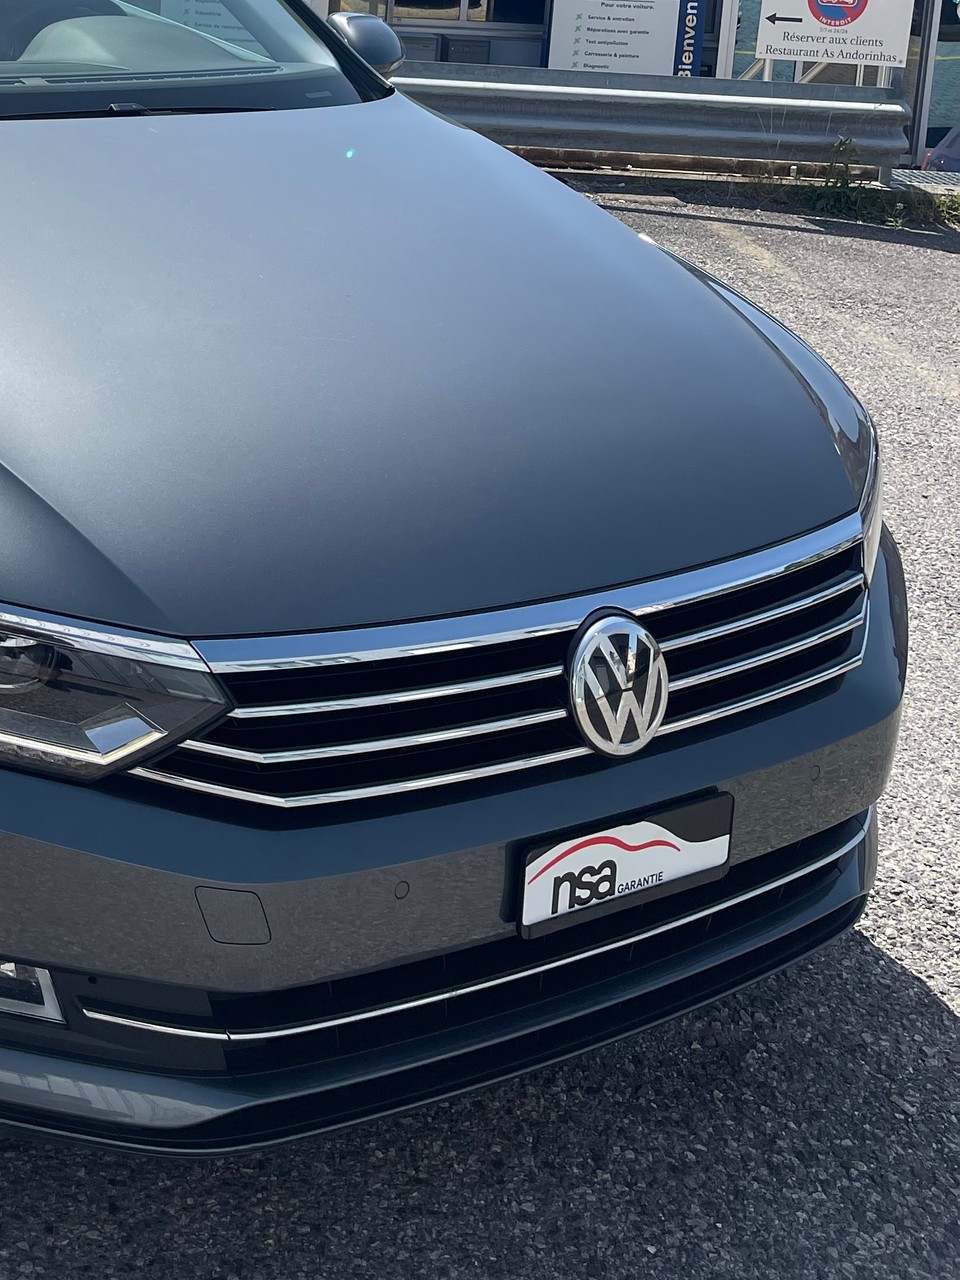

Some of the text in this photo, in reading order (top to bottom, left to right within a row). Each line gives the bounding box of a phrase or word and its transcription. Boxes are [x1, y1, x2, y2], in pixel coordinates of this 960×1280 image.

[819, 16, 852, 26] INTERDIT
[782, 31, 884, 47] Réserver aux clients
[765, 44, 897, 62] Restaurant As Andorinhas
[551, 859, 664, 915] nsa GARANTIE
